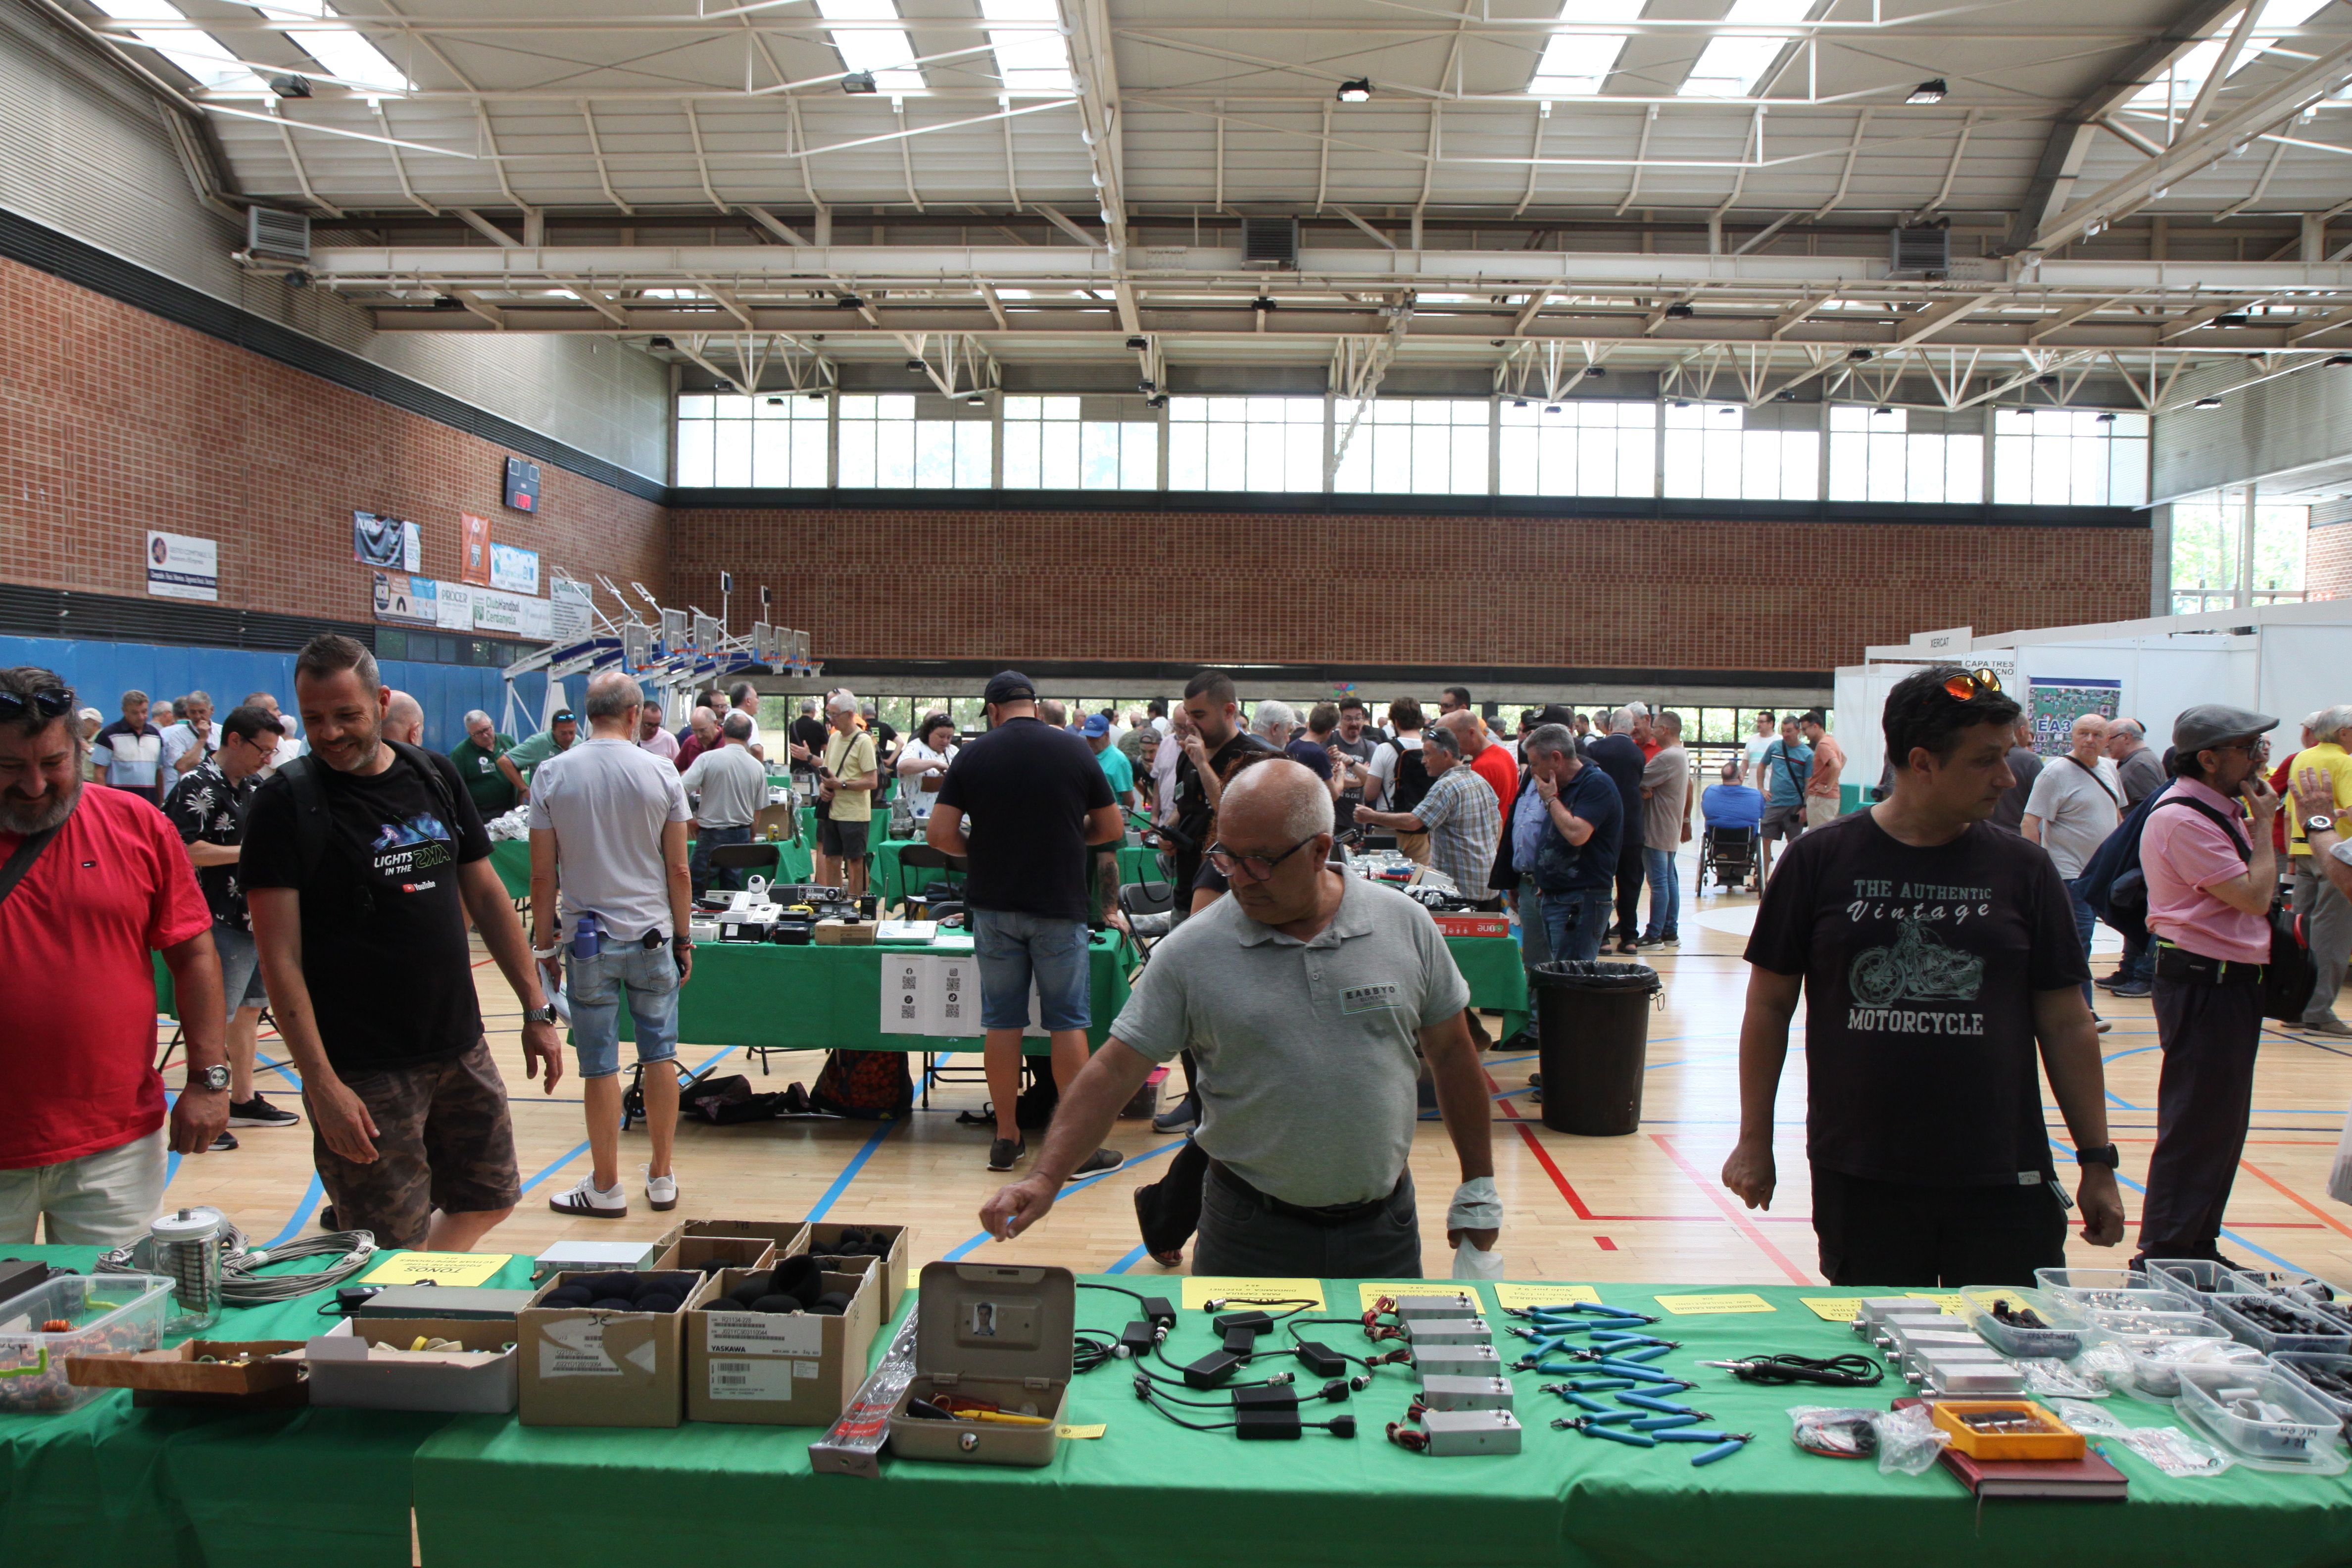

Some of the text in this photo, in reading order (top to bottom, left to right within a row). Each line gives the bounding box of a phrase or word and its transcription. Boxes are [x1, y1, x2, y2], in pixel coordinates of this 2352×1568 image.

[1930, 637, 1950, 648] XERCAT
[2037, 719, 2073, 733] EA3
[374, 851, 413, 868] LIGHTS
[385, 864, 412, 876] IN THE
[413, 881, 436, 891] YouTube
[1854, 880, 1992, 900] THE AUTHENTIC
[1847, 900, 1990, 925] Vintage
[1847, 1009, 1984, 1035] MOTORCYCLE
